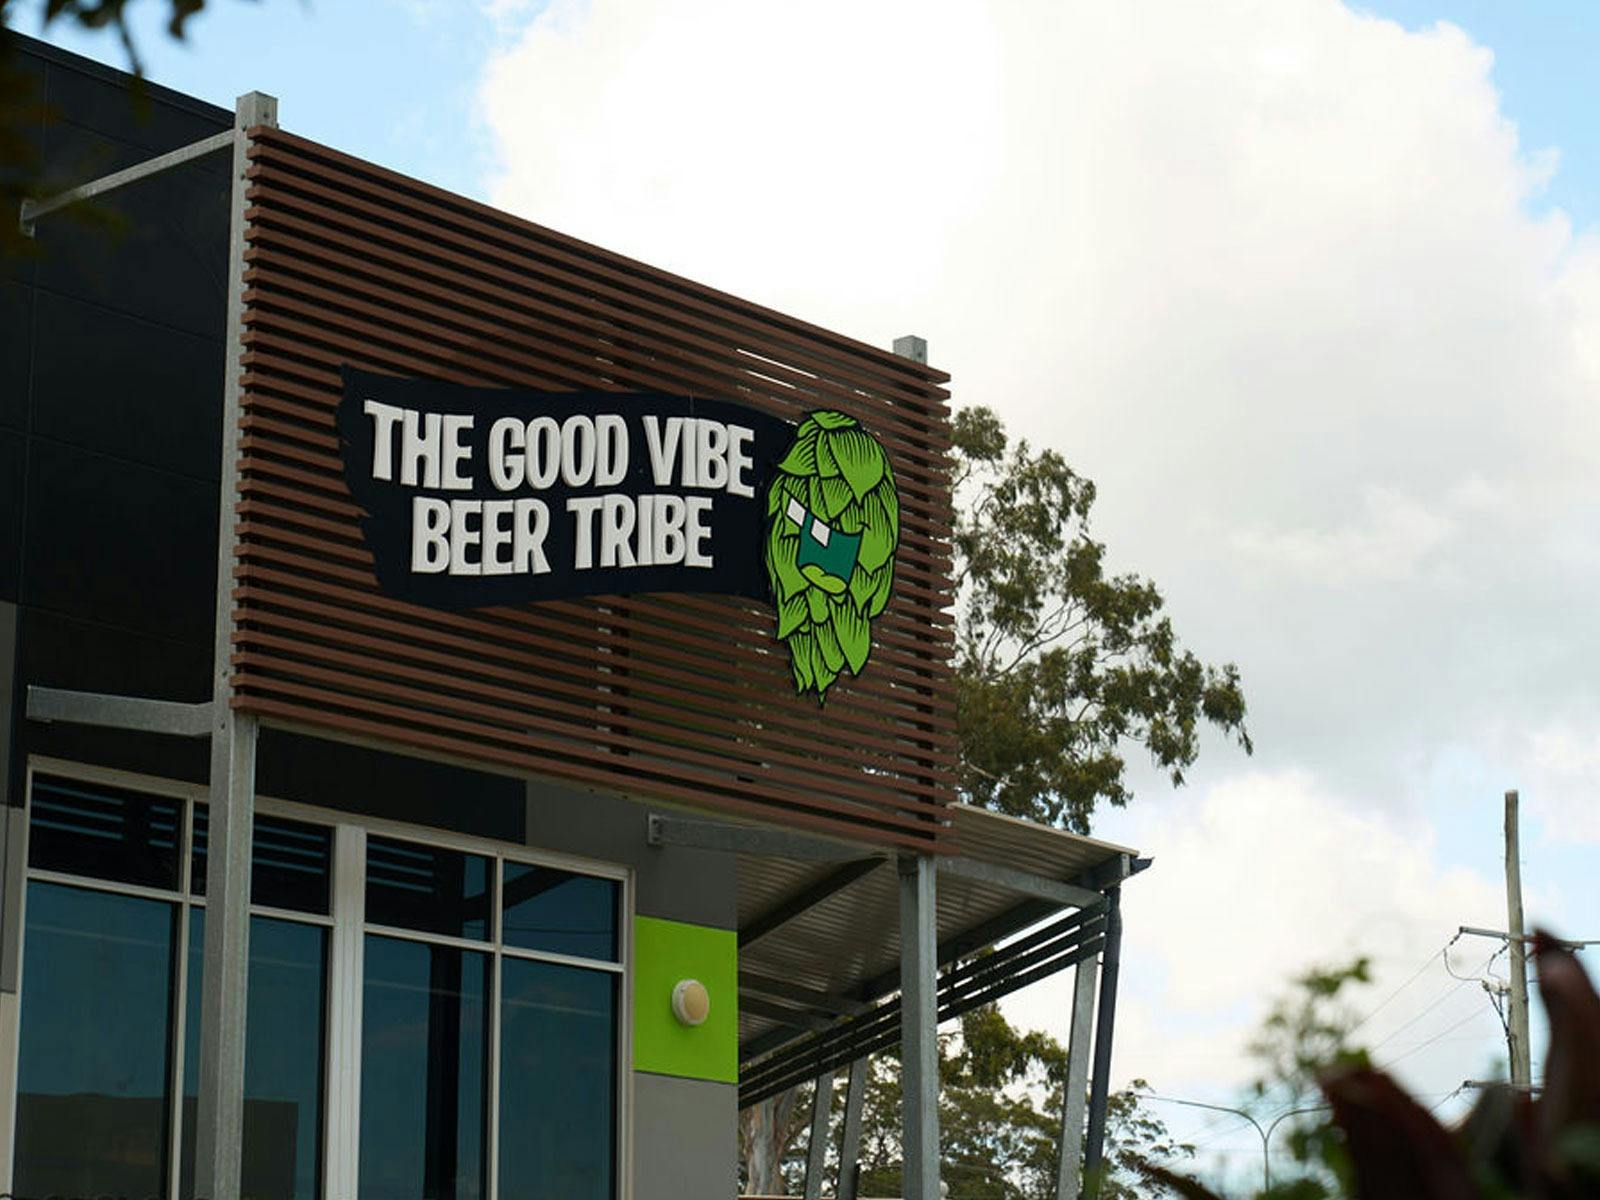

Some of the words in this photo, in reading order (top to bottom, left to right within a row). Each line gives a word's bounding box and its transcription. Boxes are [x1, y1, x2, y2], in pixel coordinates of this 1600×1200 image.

[364, 400, 474, 489] THE
[489, 415, 629, 491] GOOD
[643, 416, 754, 498] VIBE
[412, 496, 551, 575] BEER
[567, 494, 713, 569] TRIBE
